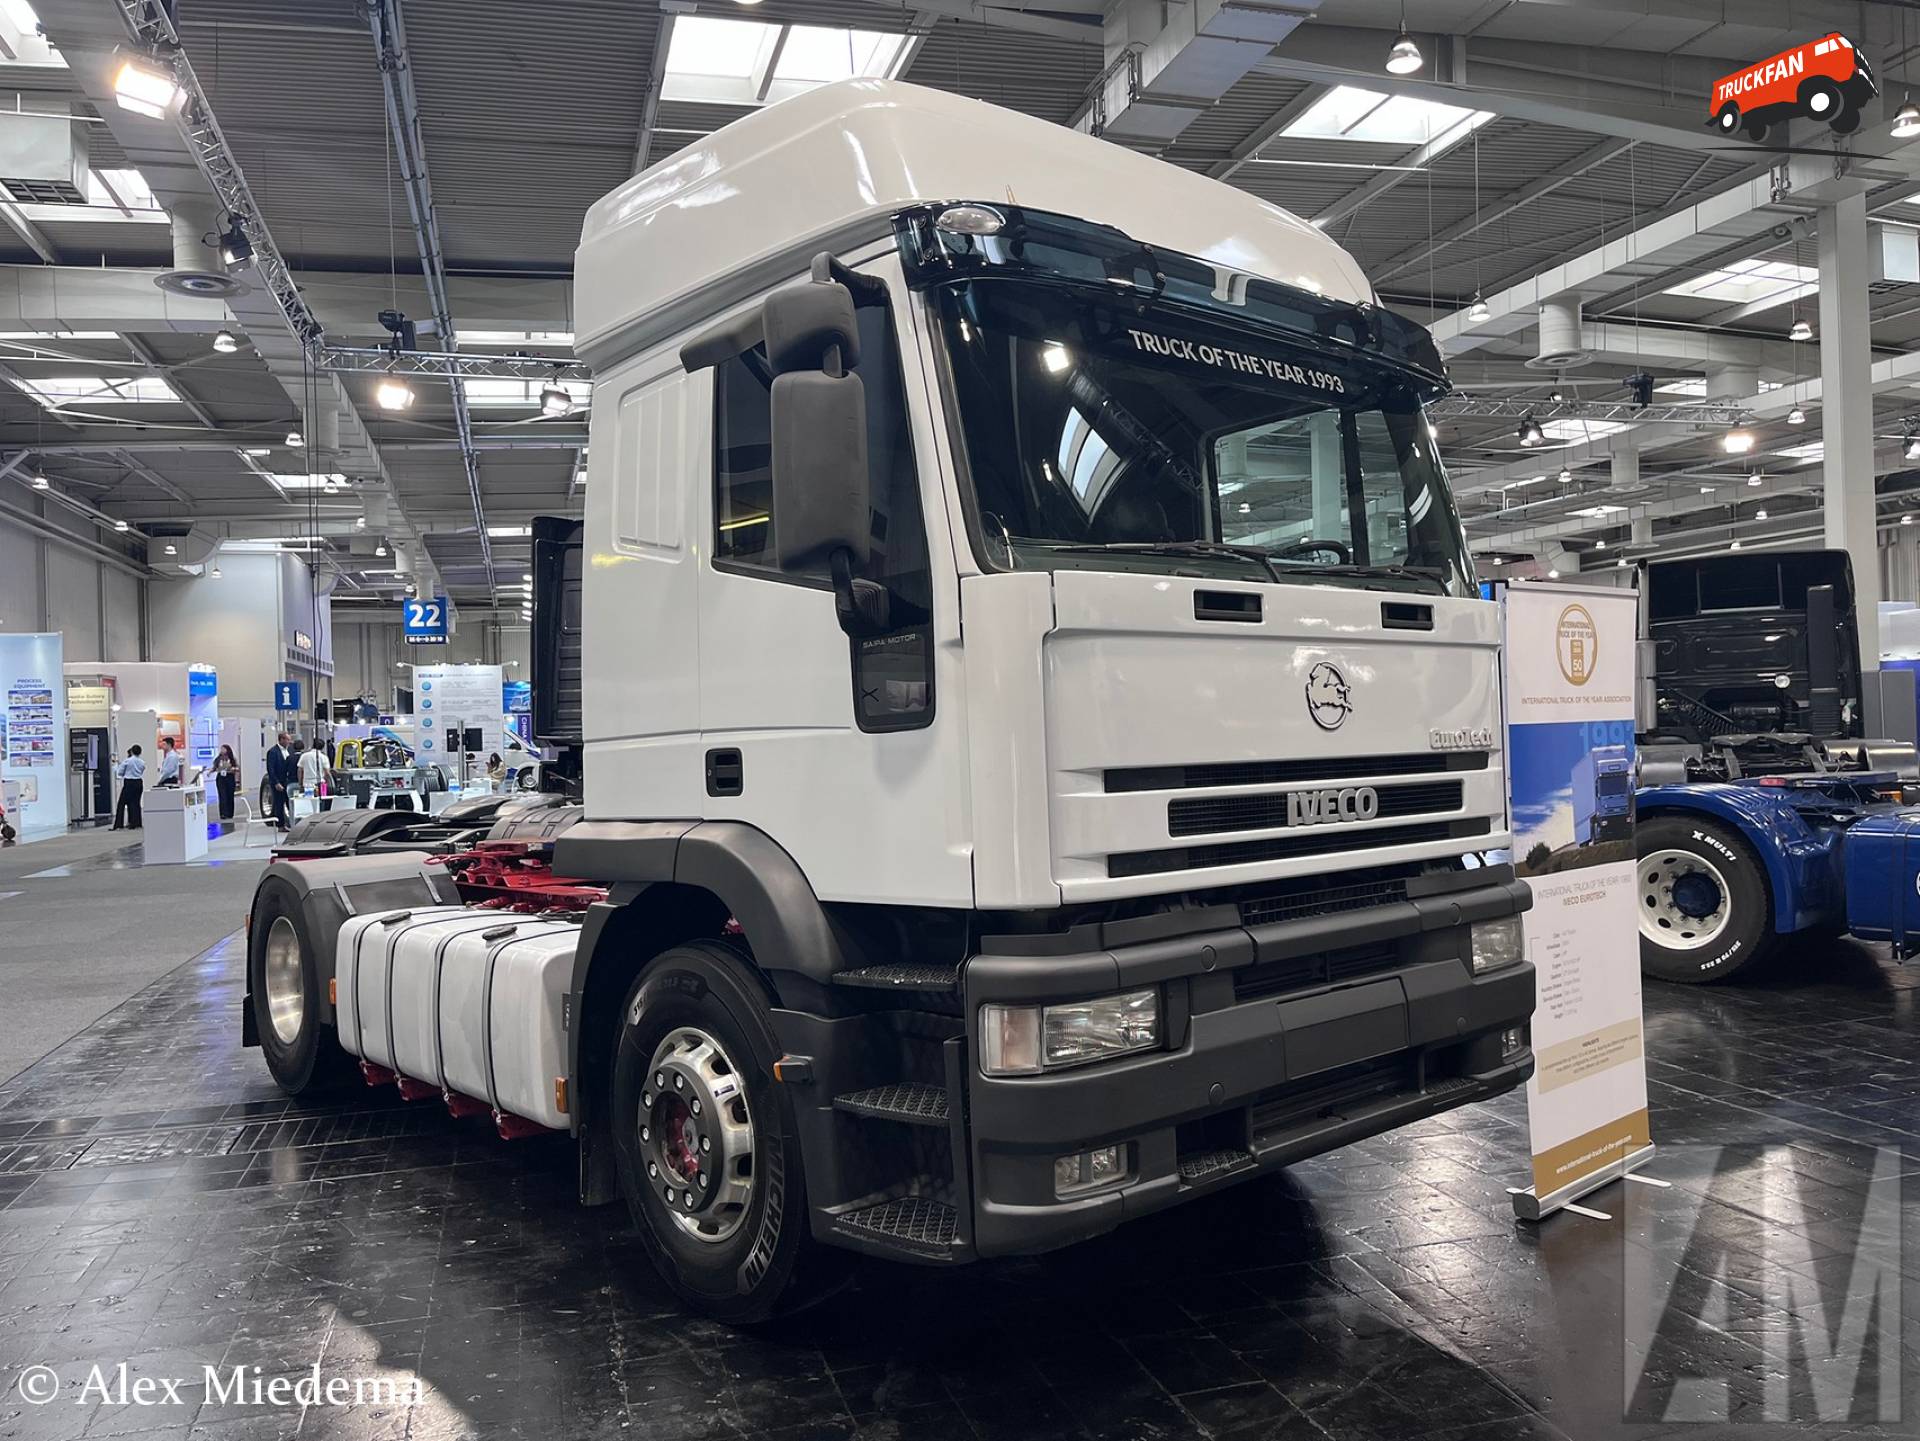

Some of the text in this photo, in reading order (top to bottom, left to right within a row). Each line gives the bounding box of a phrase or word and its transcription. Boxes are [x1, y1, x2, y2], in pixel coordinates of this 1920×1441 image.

[1128, 329, 1345, 394] TRUCK OF THE YEAR 1993
[409, 604, 441, 627] 22
[1287, 787, 1379, 827] IVECO
[1692, 830, 1737, 861] X MULTI
